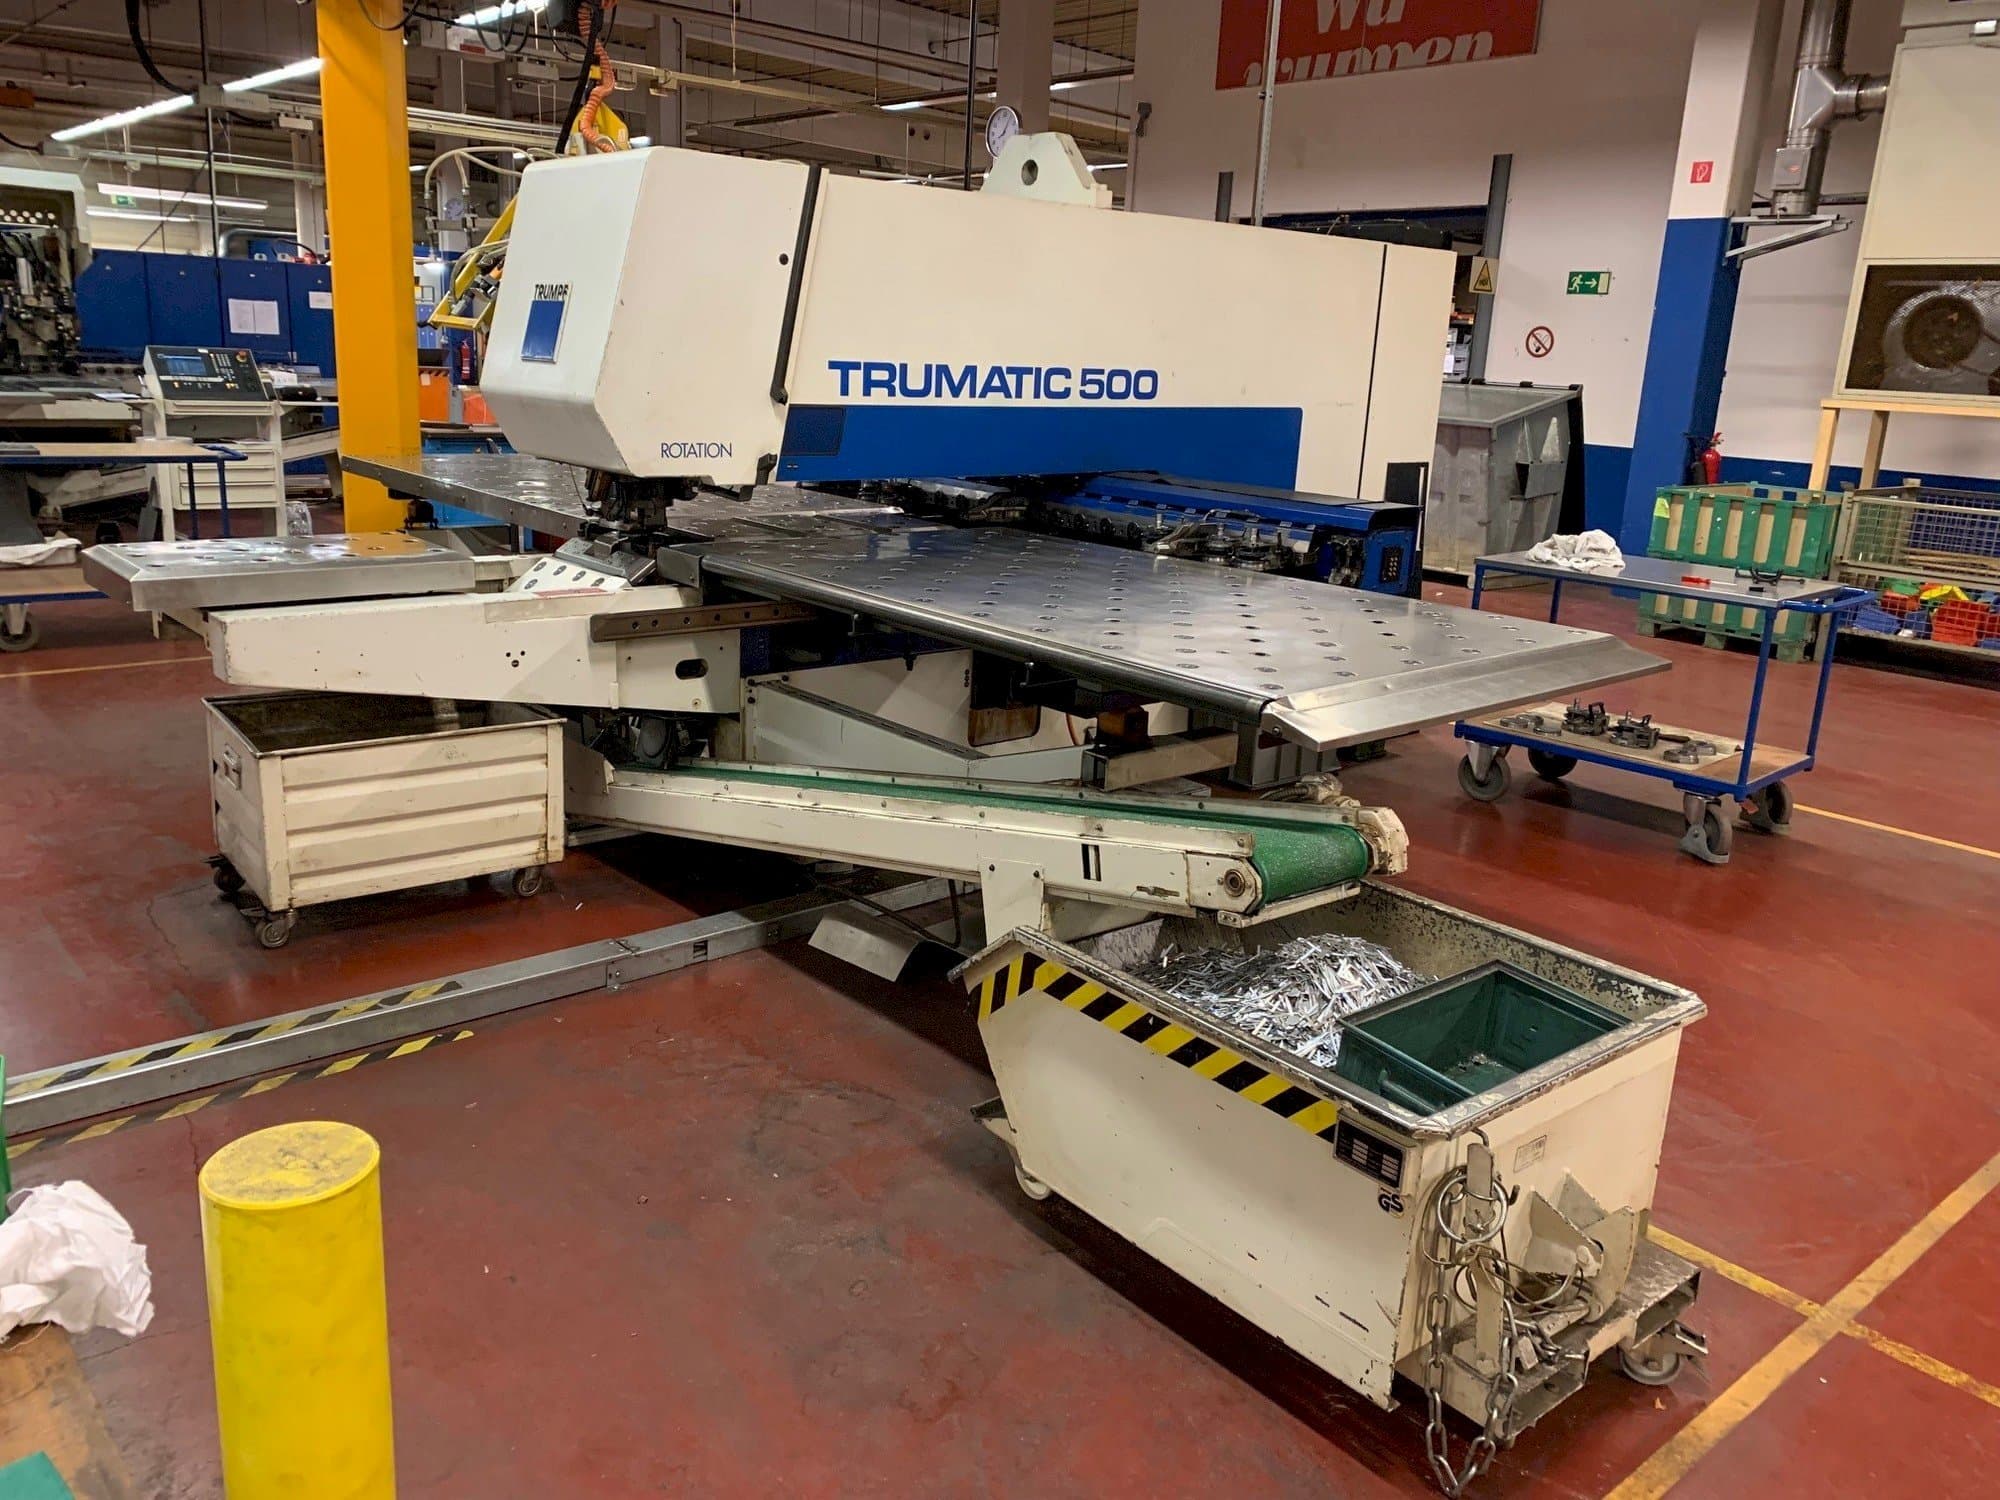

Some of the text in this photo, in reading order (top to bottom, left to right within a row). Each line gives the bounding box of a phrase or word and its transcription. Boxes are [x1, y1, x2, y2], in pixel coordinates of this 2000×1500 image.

[534, 284, 569, 300] TRUMPF
[828, 360, 1159, 400] TRUMATIC 500
[660, 442, 732, 458] ROTATION
[1378, 1193, 1404, 1213] GS
